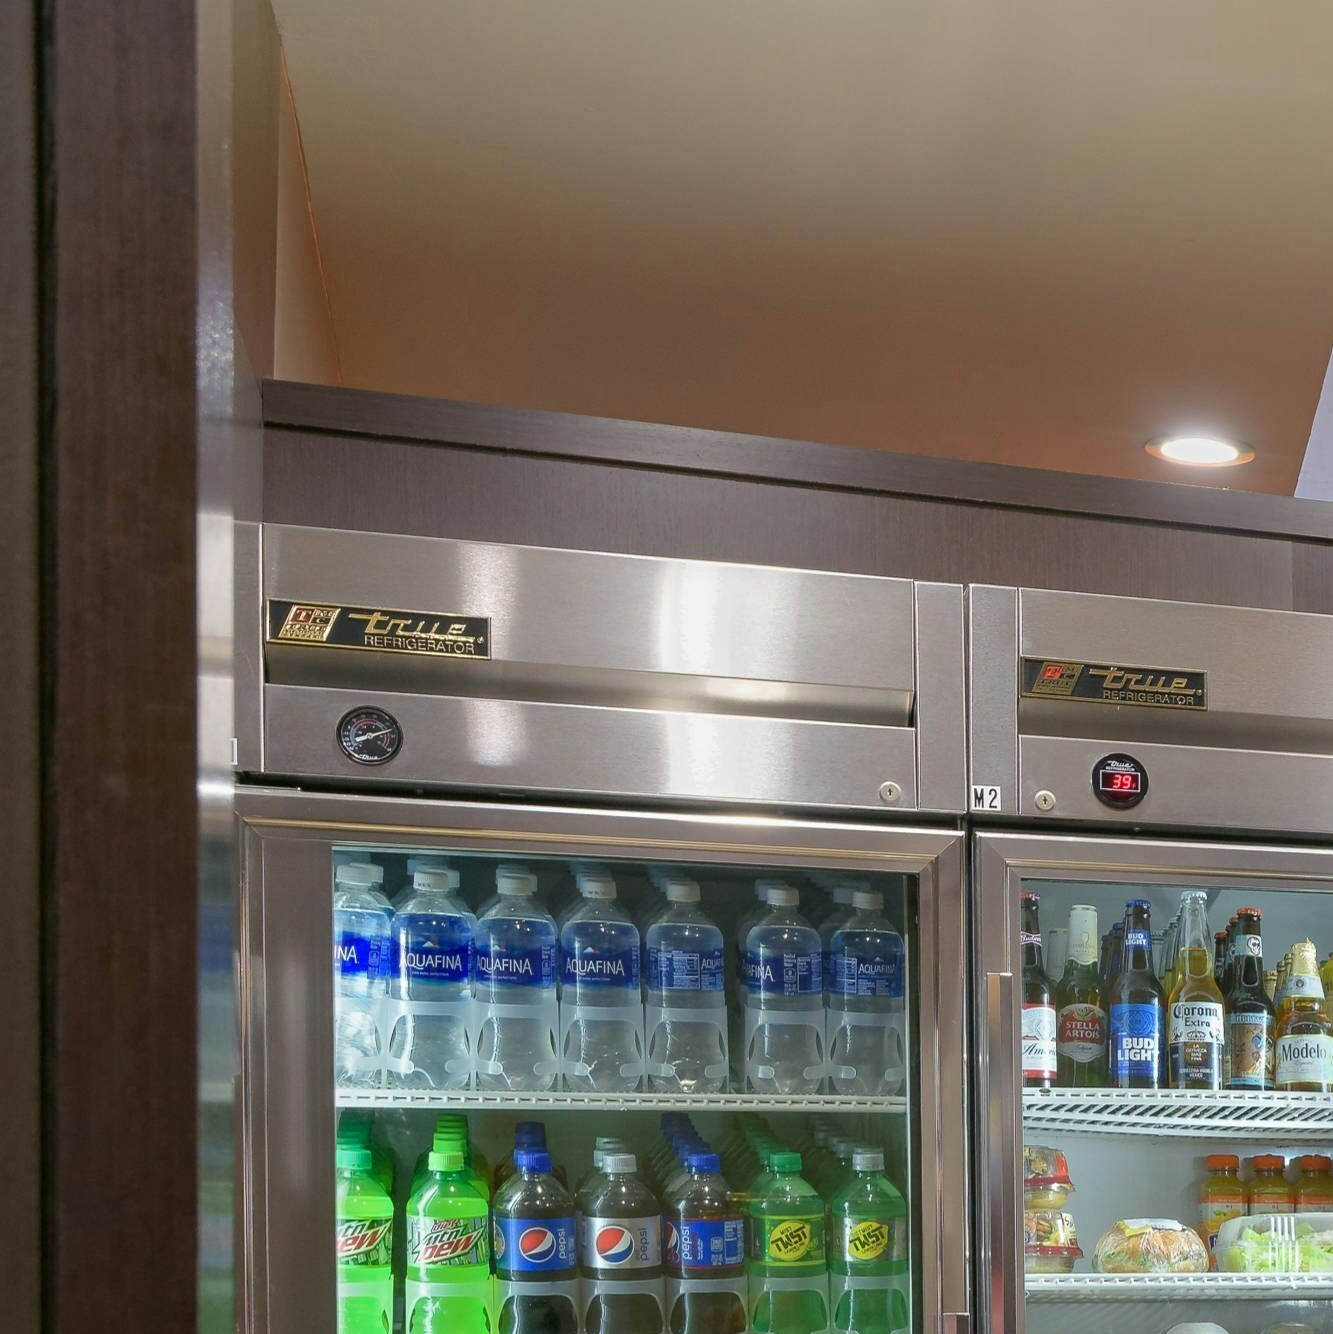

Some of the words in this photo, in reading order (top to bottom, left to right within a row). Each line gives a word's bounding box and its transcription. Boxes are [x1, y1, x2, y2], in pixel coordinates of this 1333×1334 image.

[364, 635, 475, 654] REFRIGERATOR
[1103, 690, 1194, 706] REFRIGERATOR
[1125, 938, 1148, 946] LIGHT
[399, 952, 463, 972] AQUAFINA
[477, 955, 533, 976] AQUAFINA
[565, 957, 625, 976] AQUAFINA
[858, 963, 897, 975] AQUAFINA
[1173, 1003, 1218, 1020] Corona
[1065, 1021, 1099, 1031] STELLA
[1184, 1017, 1211, 1027] Extra
[1065, 1029, 1100, 1040] ARTOIS
[1122, 1038, 1154, 1050] BUD
[1282, 1040, 1328, 1061] Modelo
[1117, 1049, 1160, 1062] LIGHT
[558, 1228, 567, 1260] pepsi
[640, 1227, 648, 1262] pepsi
[682, 1225, 690, 1261] pepsi
